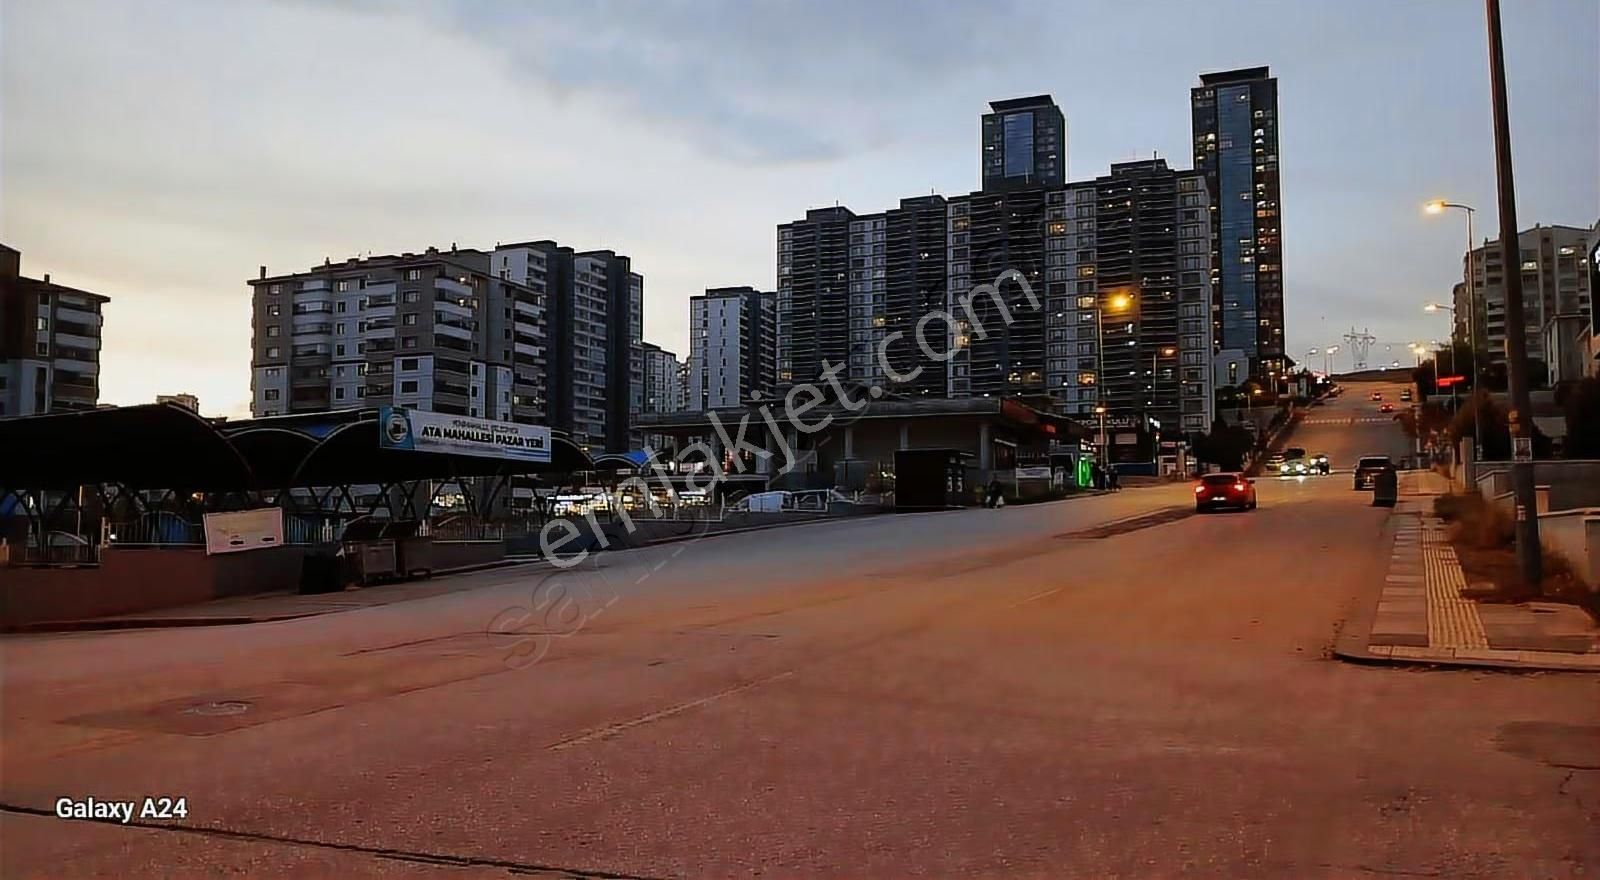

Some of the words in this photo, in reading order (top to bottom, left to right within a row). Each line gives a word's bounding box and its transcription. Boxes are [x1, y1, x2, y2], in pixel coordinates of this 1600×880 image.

[421, 426, 442, 438] ATA
[496, 434, 524, 446] PAZAR
[524, 436, 544, 448] YERİ
